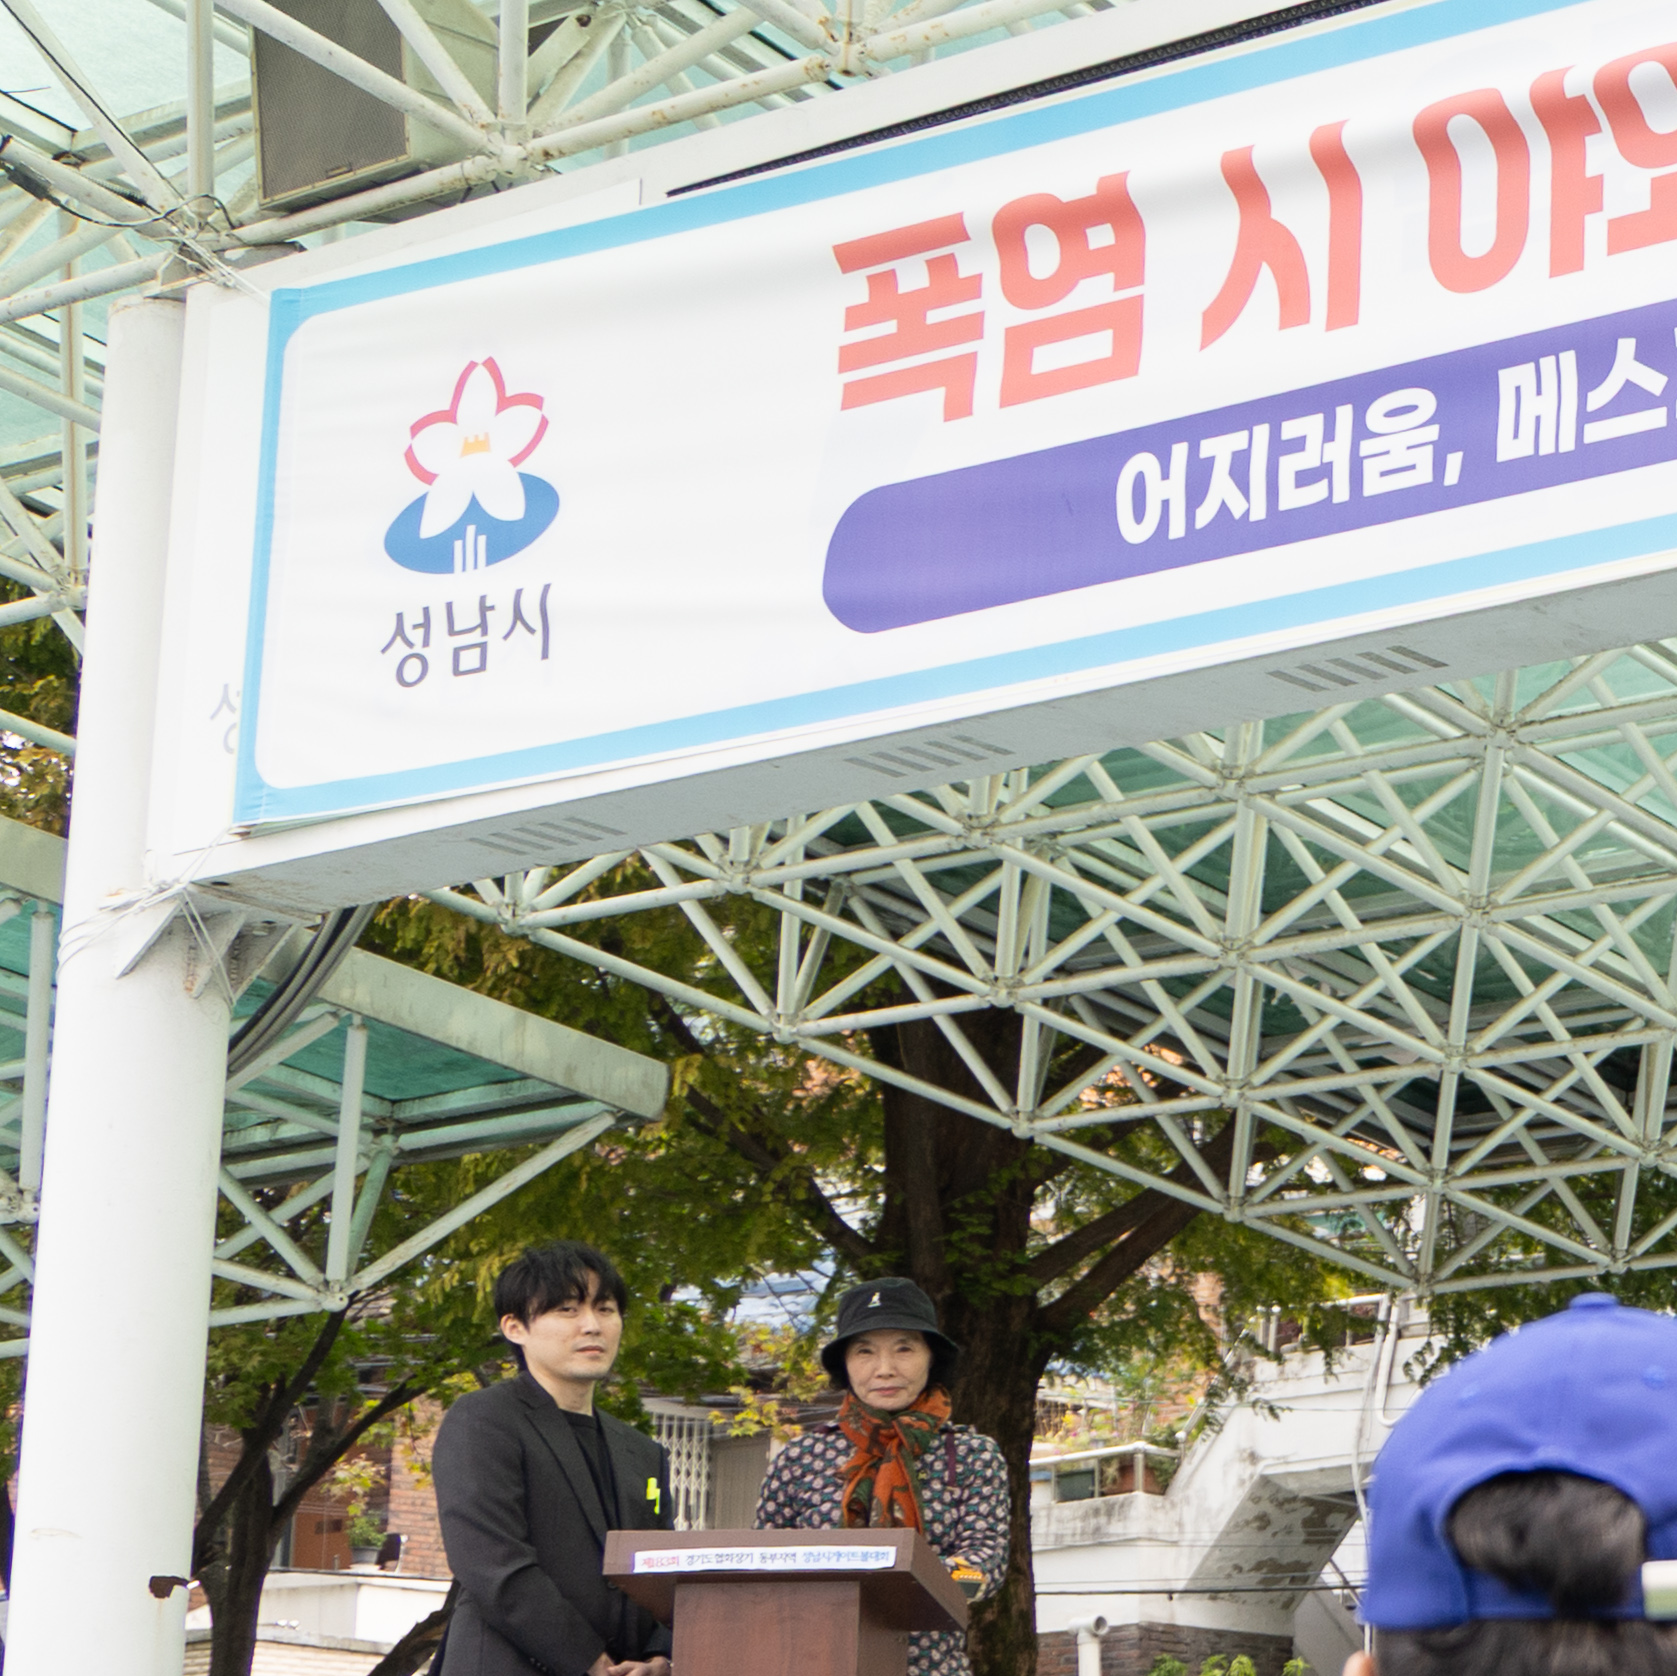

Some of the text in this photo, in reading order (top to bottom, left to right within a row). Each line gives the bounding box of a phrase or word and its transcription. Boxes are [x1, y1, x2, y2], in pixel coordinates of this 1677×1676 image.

[833, 174, 1145, 422] 폭염
[1201, 125, 1362, 349] 시
[1116, 388, 1464, 545] 어지러움,
[381, 584, 551, 688] 성남시
